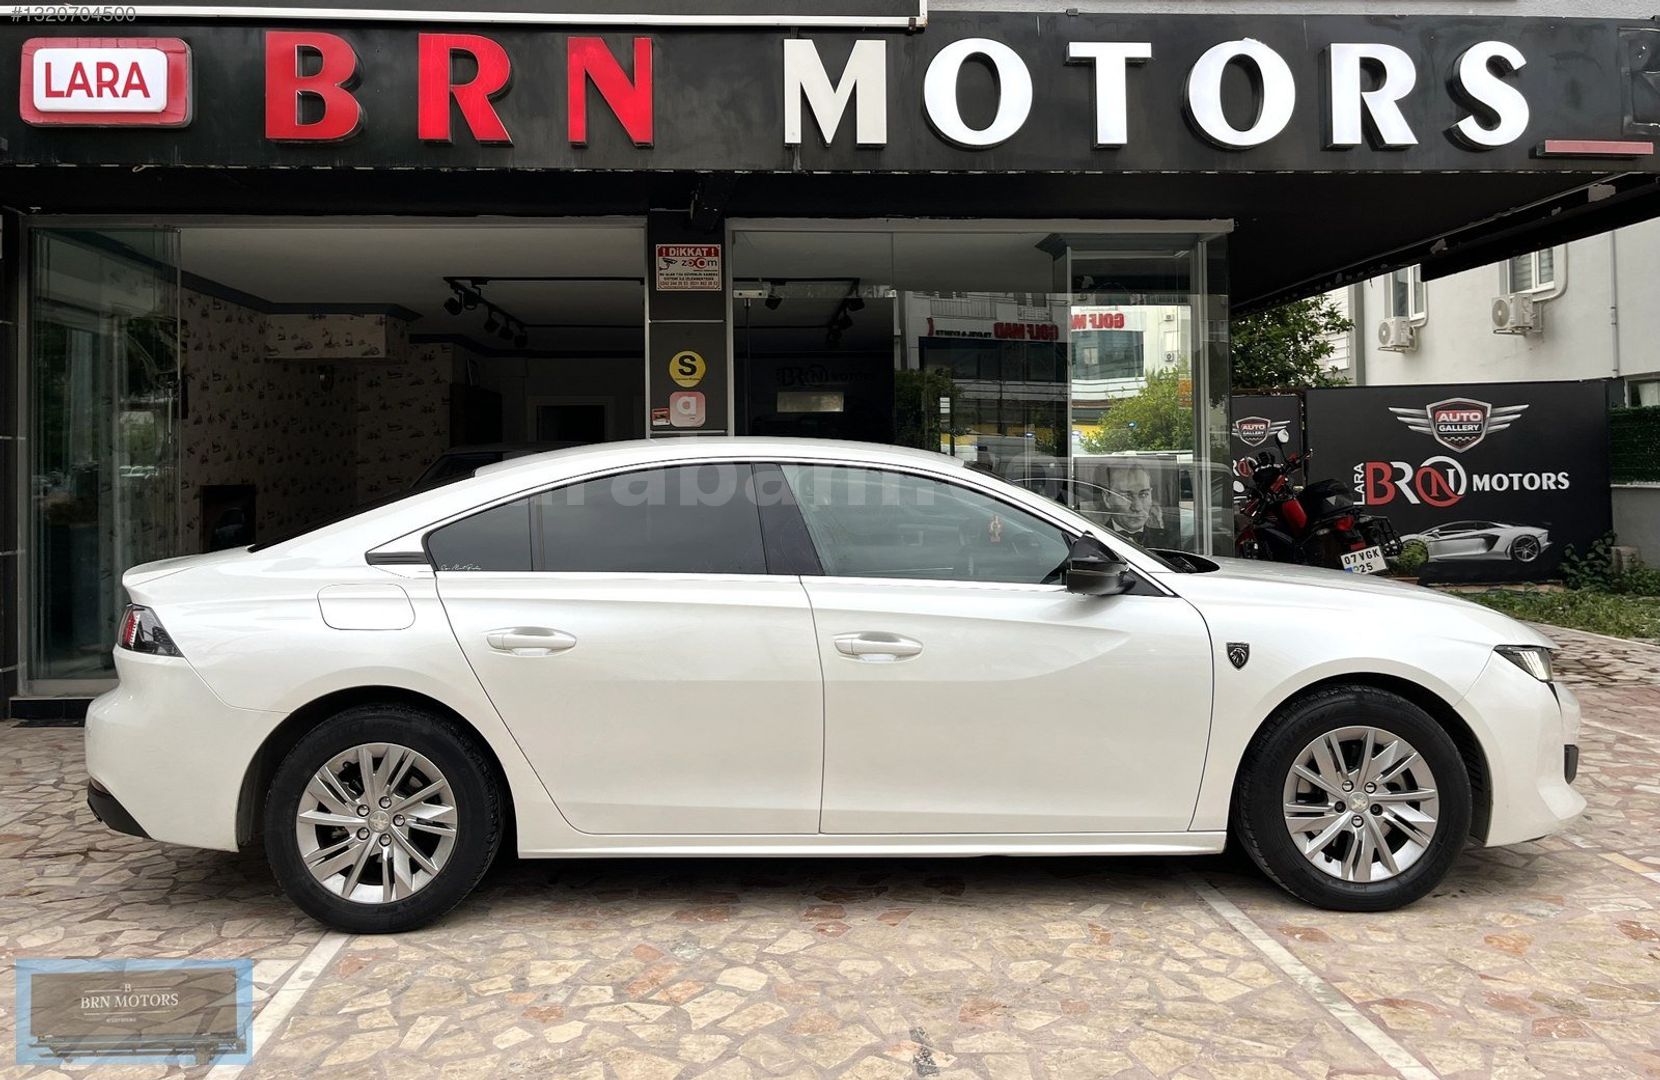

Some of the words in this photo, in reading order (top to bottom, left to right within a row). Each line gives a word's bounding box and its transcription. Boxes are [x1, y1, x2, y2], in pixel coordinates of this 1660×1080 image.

[44, 61, 150, 99] LARA
[265, 31, 654, 146] BRN
[783, 37, 1531, 149] MOTORS
[678, 354, 697, 376] S
[1438, 412, 1481, 422] AUTO
[1242, 423, 1266, 431] AUTO
[1439, 424, 1480, 432] GALLERY
[1353, 462, 1366, 506] LARA
[1472, 472, 1570, 492] MOTORS
[1344, 554, 1357, 565] 07
[1359, 562, 1374, 573] 25
